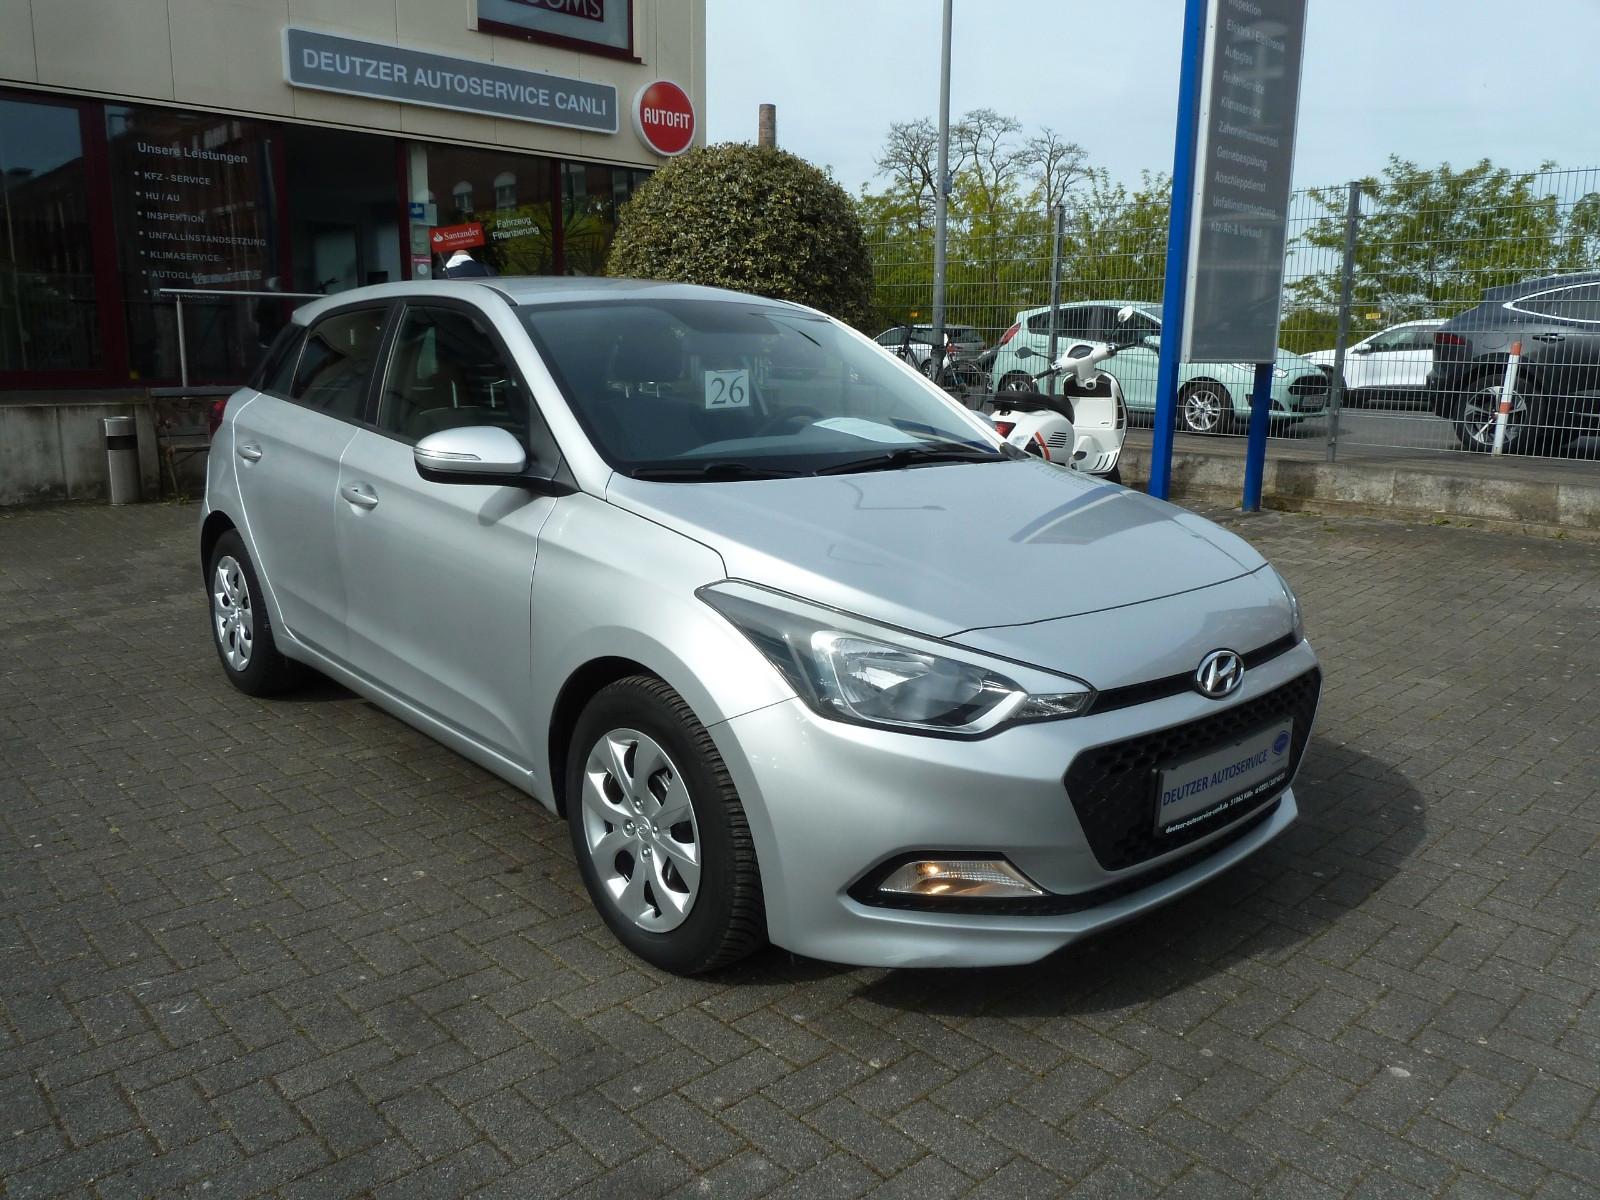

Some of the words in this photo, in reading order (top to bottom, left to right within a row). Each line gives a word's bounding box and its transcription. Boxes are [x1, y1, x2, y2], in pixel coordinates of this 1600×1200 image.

[303, 49, 408, 83] DEUTZER
[414, 68, 550, 107] AUTOSERVICE
[555, 92, 606, 116] CANLI
[644, 107, 691, 130] AUTOFIT
[137, 142, 181, 156] Unsere
[184, 147, 249, 164] Leistungen
[144, 172, 163, 181] KFZ
[171, 174, 212, 185] SERVICE
[145, 191, 159, 200] HU
[167, 193, 180, 201] AU
[147, 211, 205, 223] INSPEKTION
[496, 217, 531, 230] Fahrzeug
[149, 231, 268, 247] UNFALLINSTANDSETZUNG
[444, 227, 480, 241] Santander
[492, 225, 540, 241] Finanzierung
[150, 251, 220, 262] KLIMASERVICE
[711, 375, 745, 405] 26
[1163, 777, 1209, 806] DEUTZER
[1210, 748, 1268, 787] AUTOSERVICE
